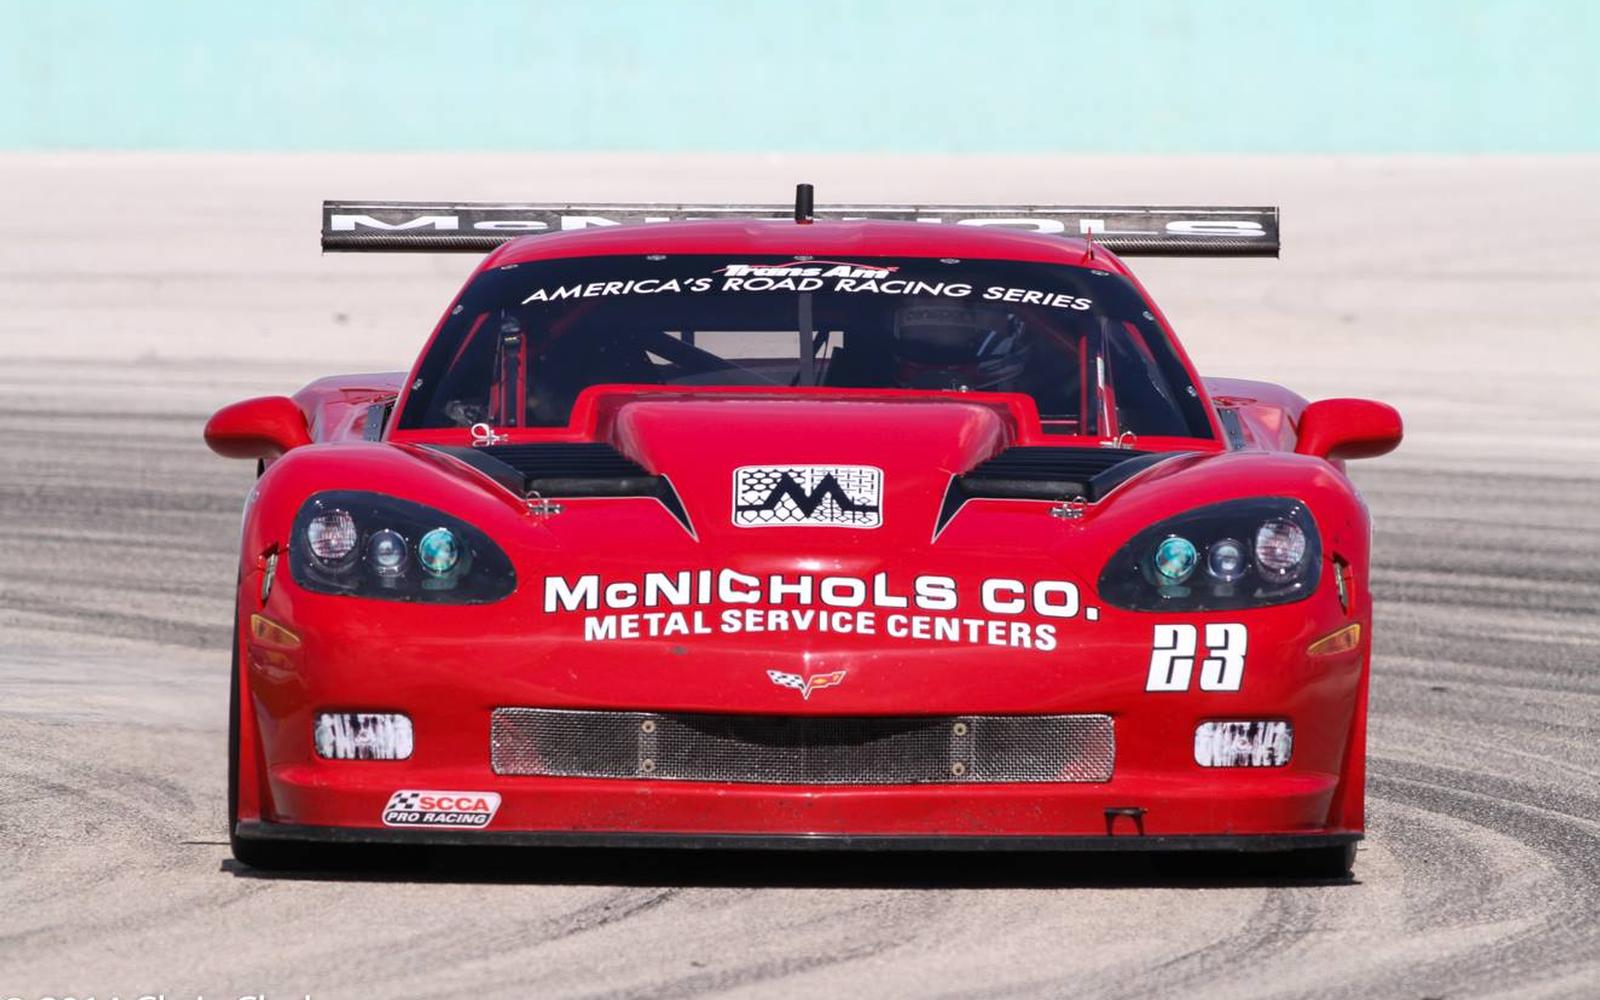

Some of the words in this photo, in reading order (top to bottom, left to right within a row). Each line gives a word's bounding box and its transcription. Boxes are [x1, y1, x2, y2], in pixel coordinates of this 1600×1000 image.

[521, 277, 713, 304] AMERICA'S
[721, 277, 824, 292] ROAD
[834, 279, 972, 298] RACING
[982, 286, 1093, 311] SERIES
[543, 567, 958, 613] McNICHOLS
[980, 577, 1099, 621] CO.
[583, 610, 712, 642] METAL
[720, 608, 876, 634] SERVICE
[886, 613, 1057, 651] CENTERS
[1145, 622, 1248, 692] 23
[386, 811, 420, 823] PRO
[423, 813, 487, 824] RACING
[419, 796, 490, 812] SCCA
